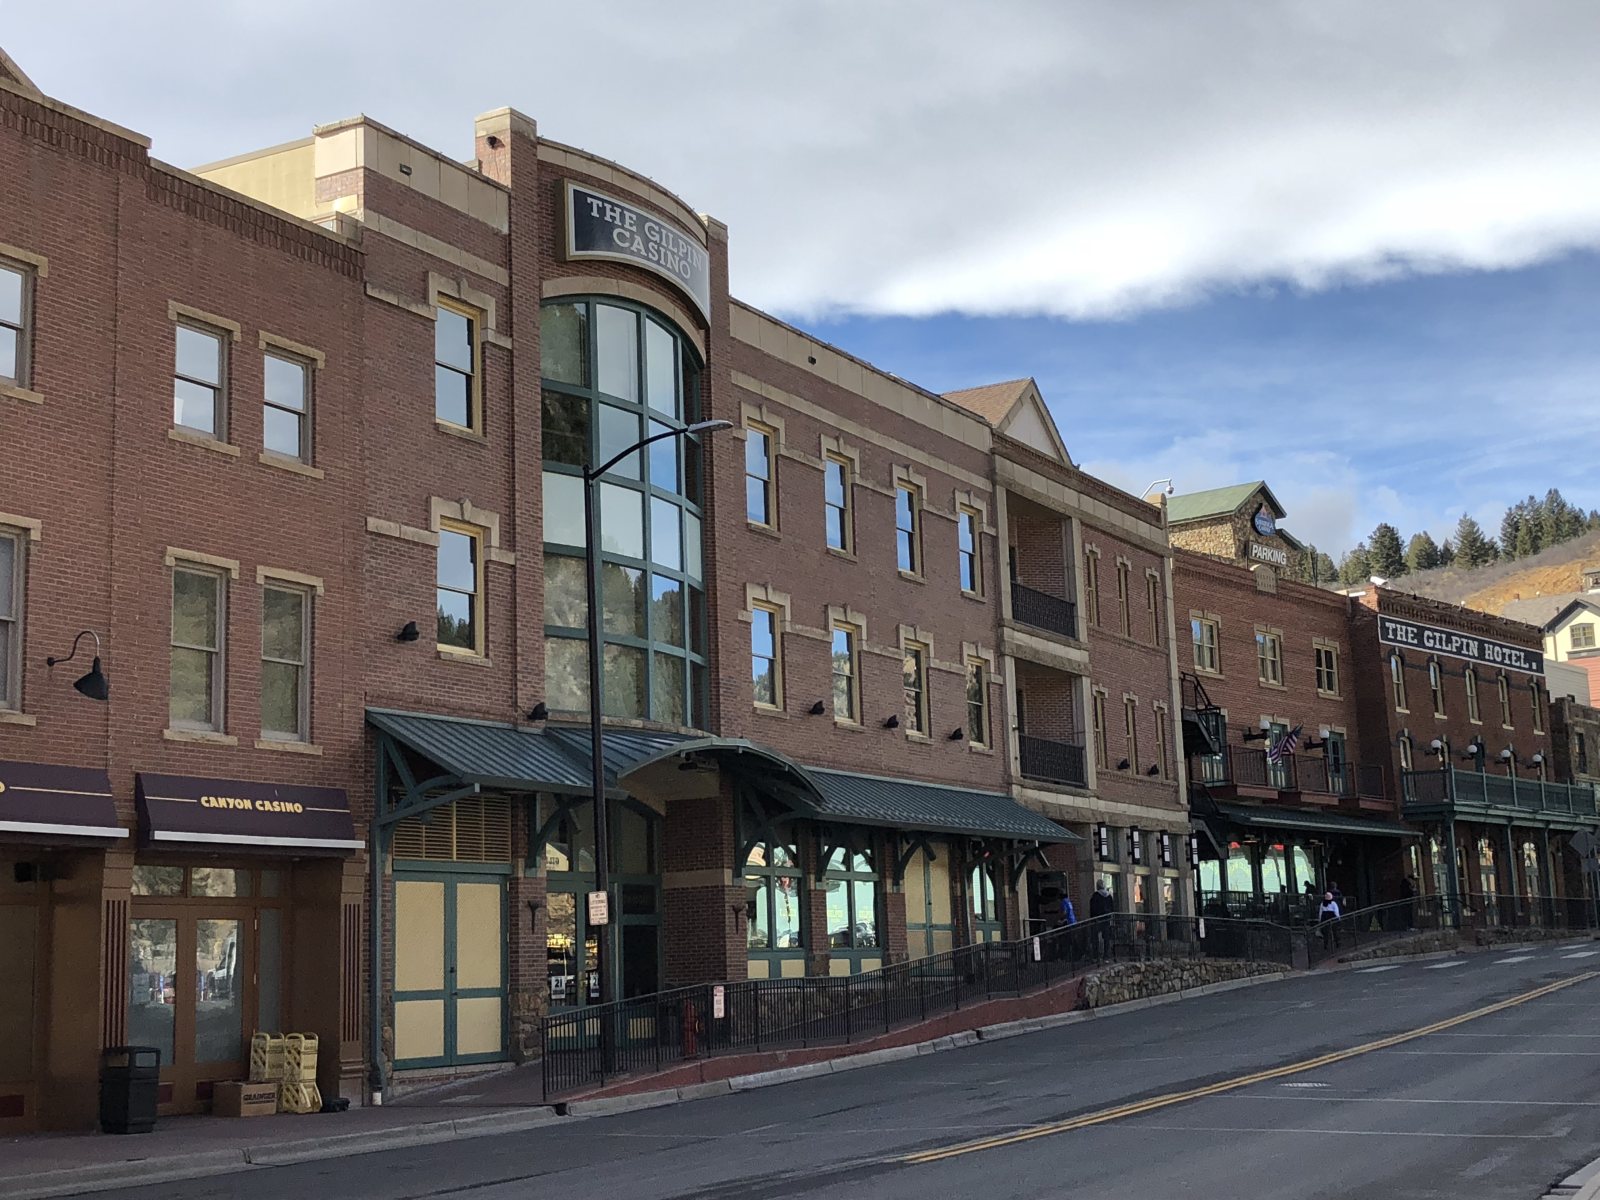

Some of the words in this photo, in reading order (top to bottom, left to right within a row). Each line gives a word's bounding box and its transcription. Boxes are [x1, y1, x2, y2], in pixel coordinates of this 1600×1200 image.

[587, 197, 637, 232] THE
[644, 221, 702, 271] GILPIN
[612, 228, 691, 279] CASINO
[1252, 544, 1287, 565] PARKING
[1385, 621, 1418, 645] THE
[1423, 630, 1479, 658] GILPIN
[200, 796, 253, 811] CANYON
[255, 800, 304, 814] CASINO
